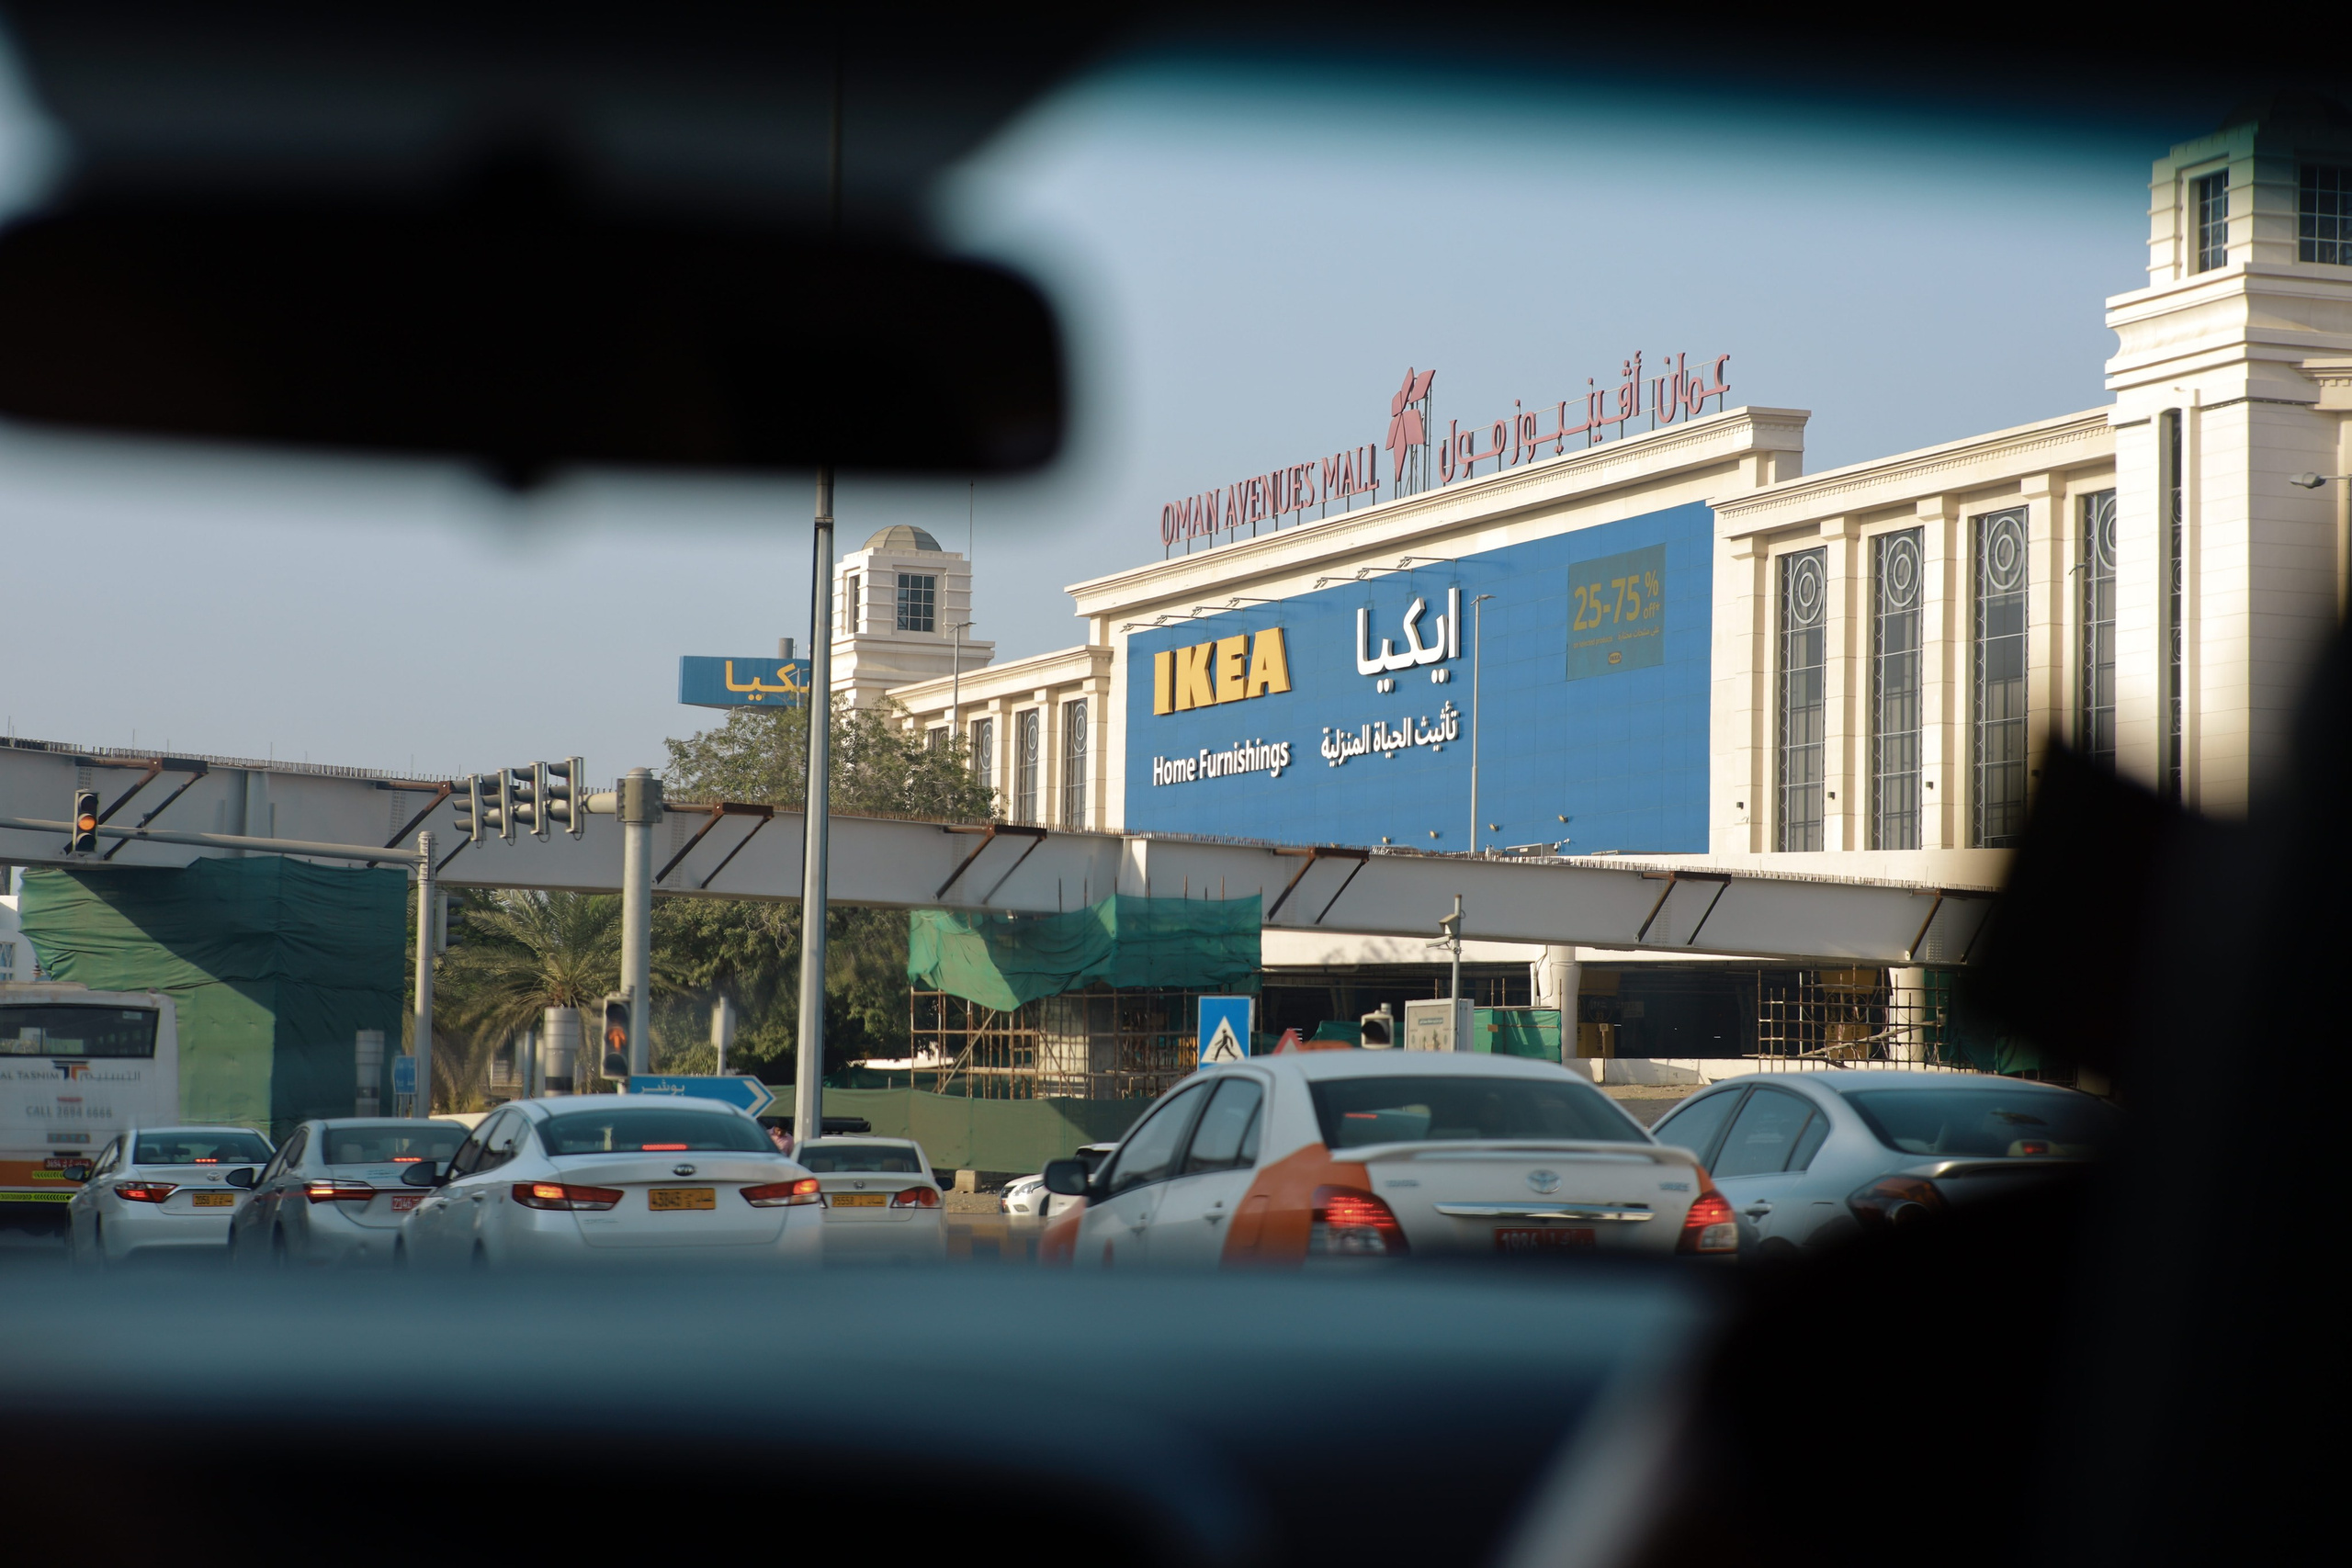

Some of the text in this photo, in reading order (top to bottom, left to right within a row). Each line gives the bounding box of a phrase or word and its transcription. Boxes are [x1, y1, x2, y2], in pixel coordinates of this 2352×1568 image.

[1656, 352, 1731, 423] عمان
[1438, 418, 1506, 483] مول
[1160, 444, 1380, 547] OMAN AVENUES MALL
[1573, 574, 1641, 631] 25-75
[1153, 626, 1292, 716] IKEA
[1356, 587, 1461, 694] ايكيا
[725, 660, 809, 702] كيا
[1153, 739, 1291, 787] Home Furnishings
[1320, 700, 1459, 768] تأثيث الحياة المنزلية
[17, 1071, 60, 1080] TASNIM
[640, 1078, 685, 1096] بوشر
[26, 1105, 52, 1118] CALL
